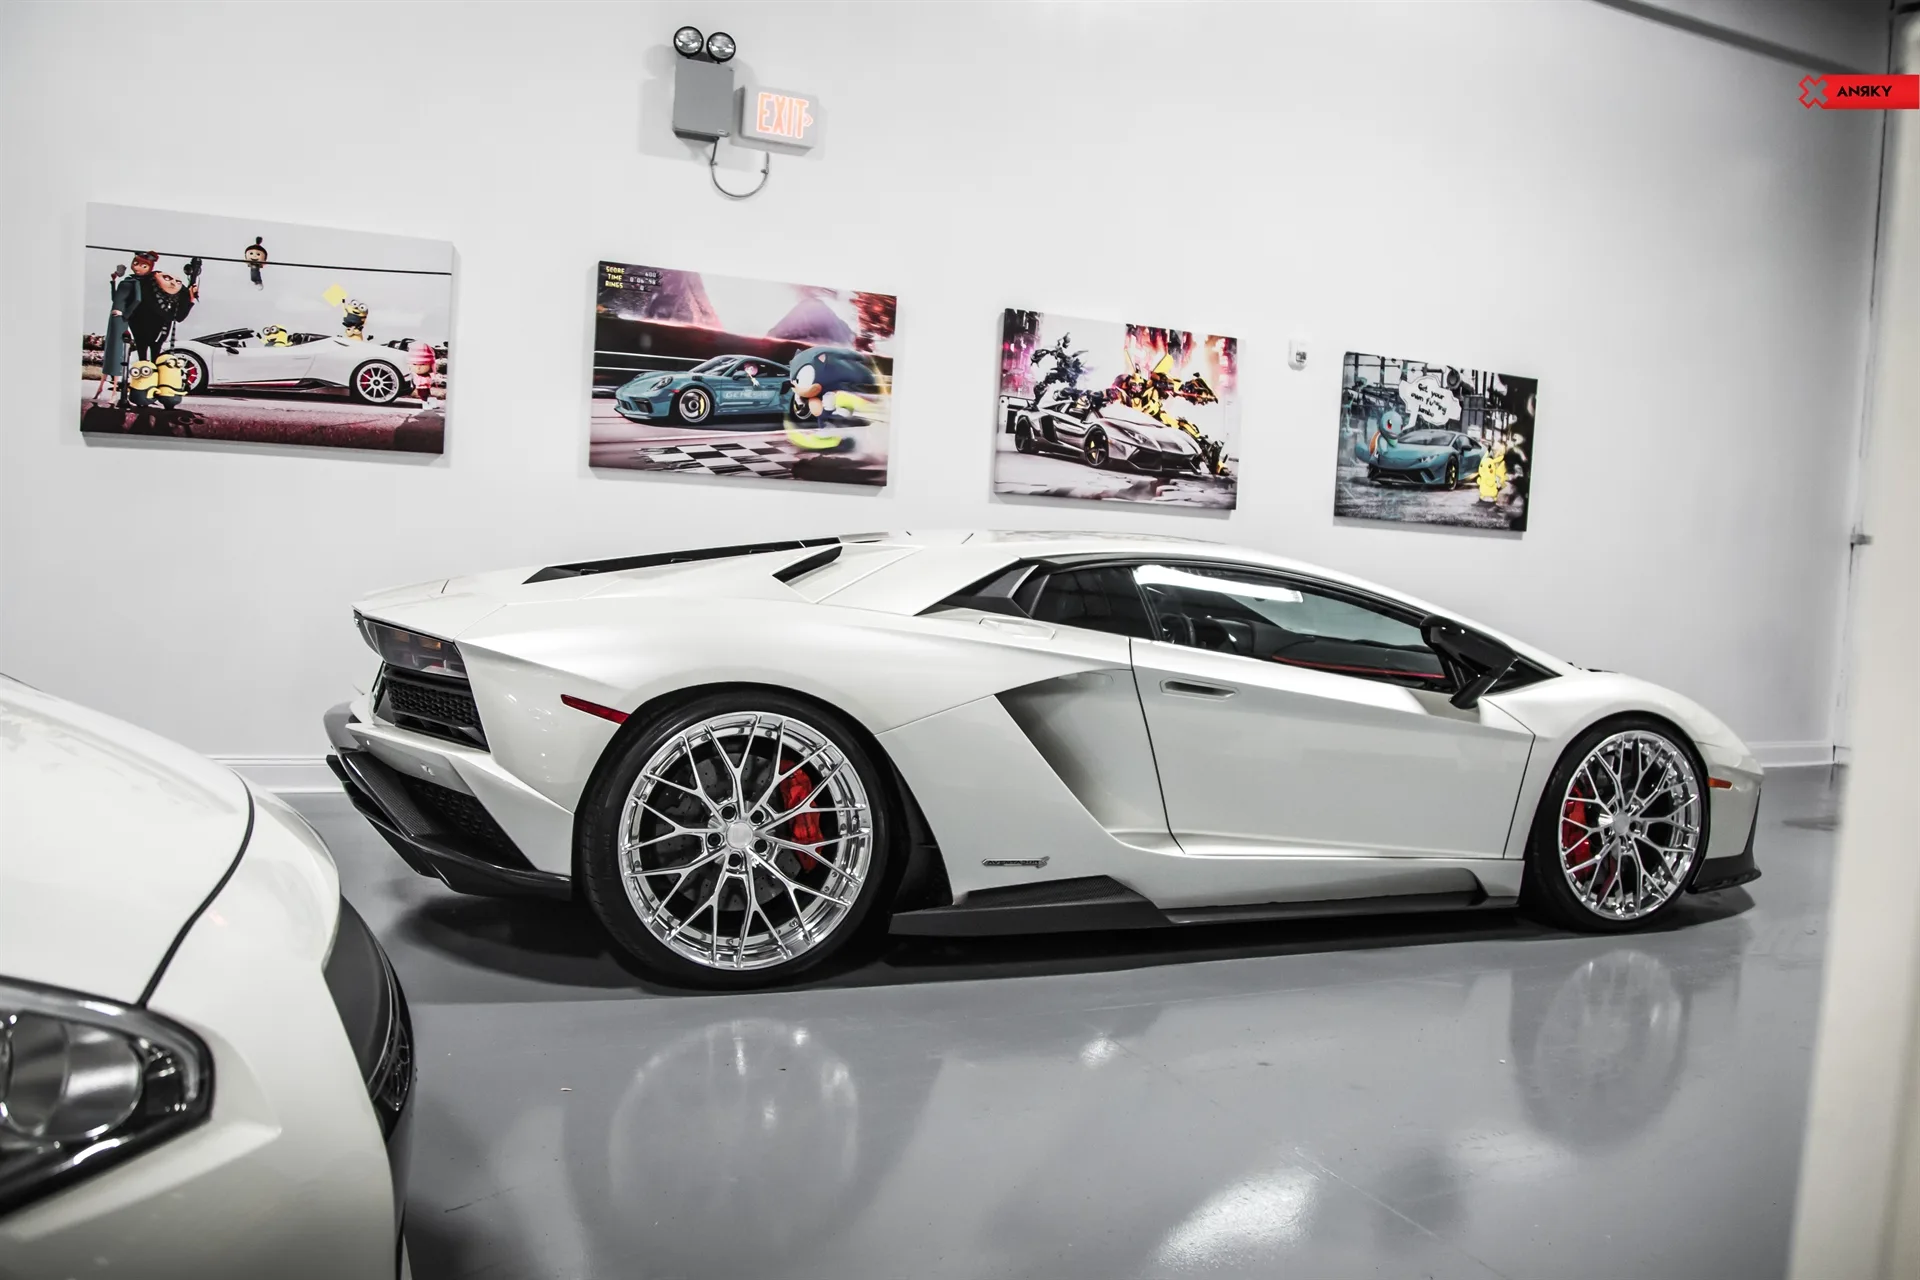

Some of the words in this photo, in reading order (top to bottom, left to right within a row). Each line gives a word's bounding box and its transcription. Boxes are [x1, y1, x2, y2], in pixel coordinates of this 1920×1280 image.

[757, 92, 809, 139] EXIT
[605, 265, 625, 274] SCORE
[607, 273, 623, 282] TIME
[604, 280, 624, 289] RINGS
